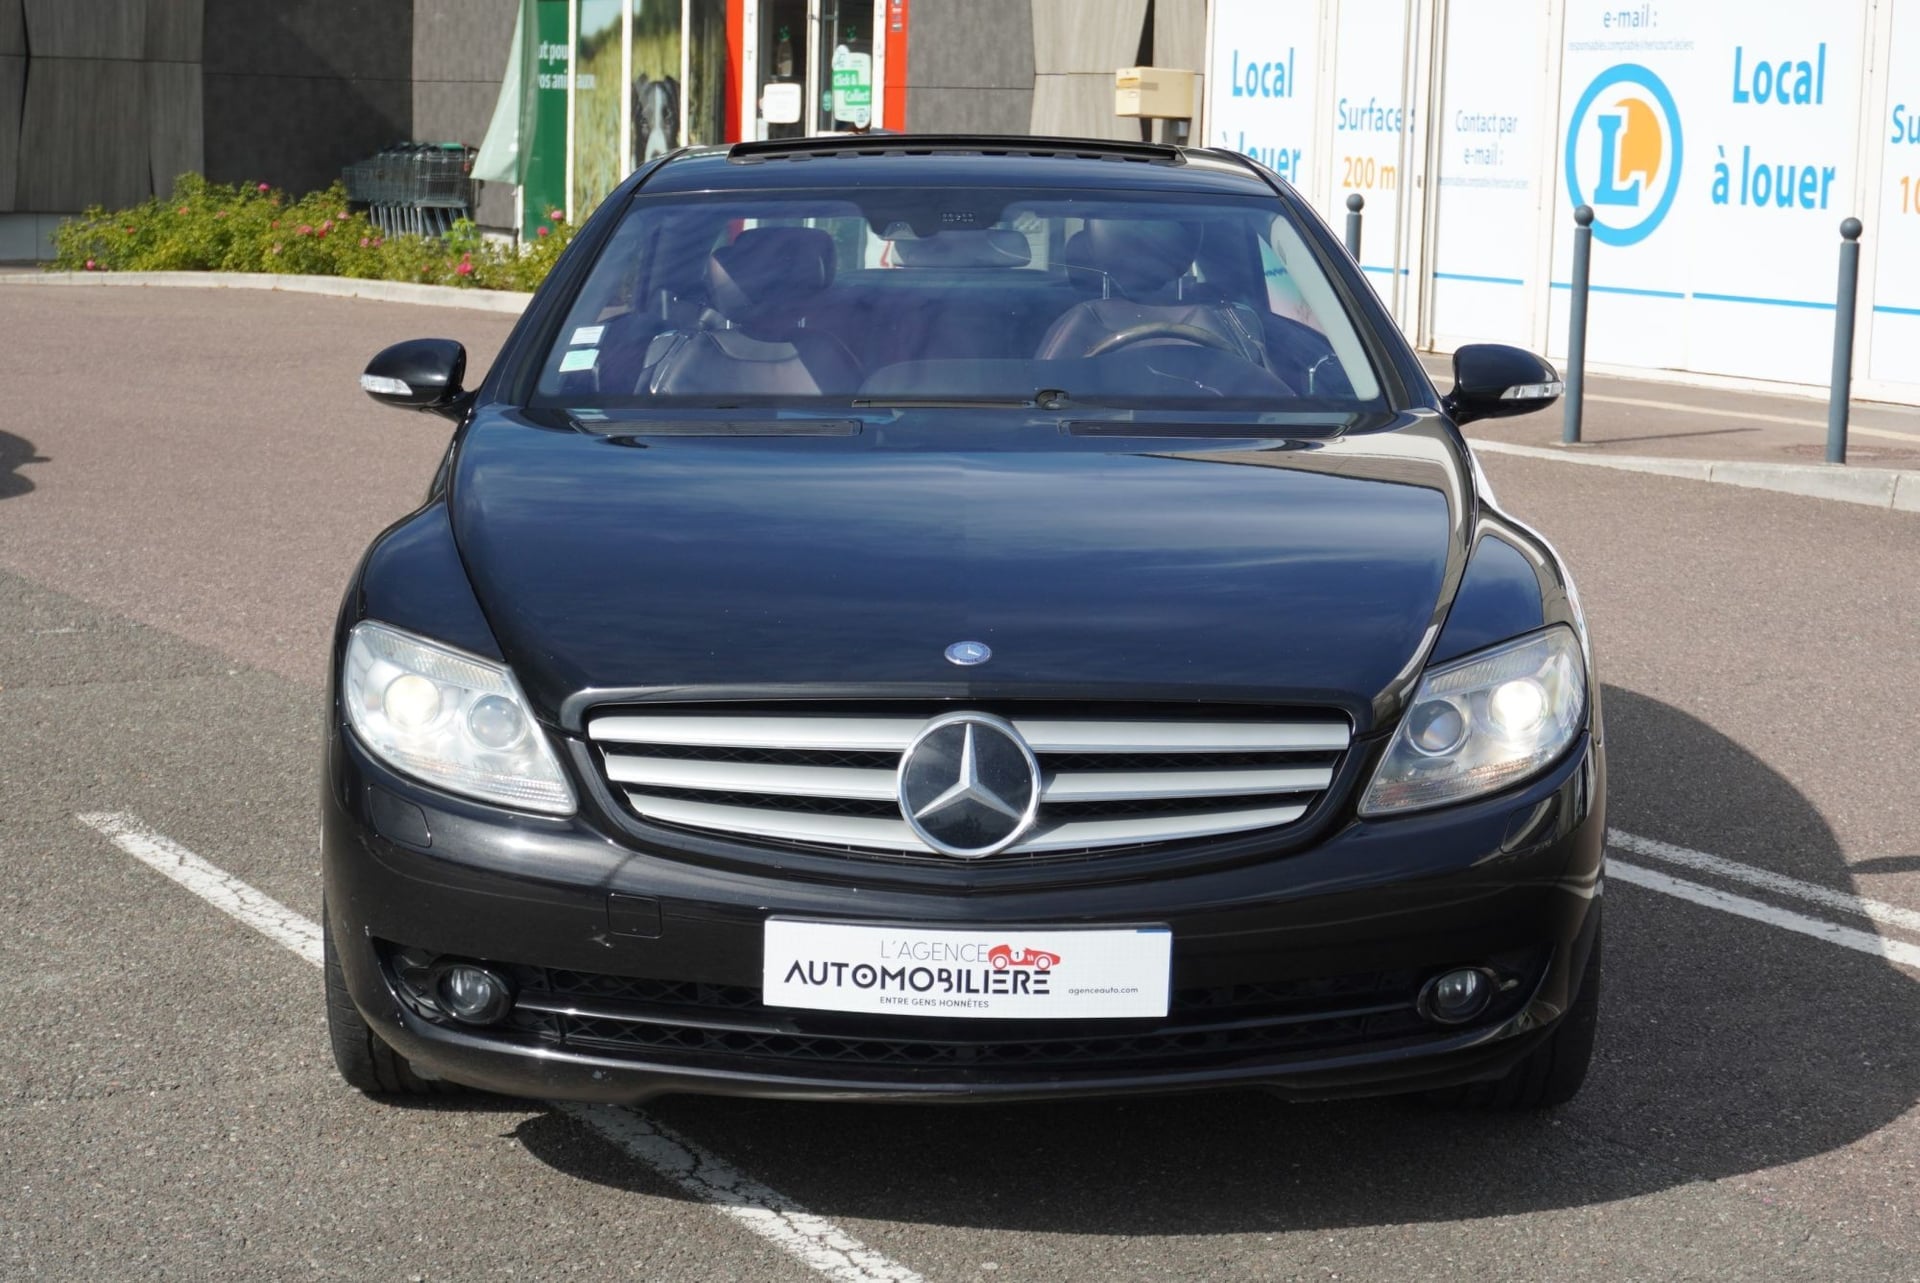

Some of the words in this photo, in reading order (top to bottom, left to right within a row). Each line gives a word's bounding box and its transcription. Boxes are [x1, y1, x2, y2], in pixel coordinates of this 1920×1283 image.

[1603, 3, 1650, 28] e-mail
[1232, 47, 1294, 98] Local
[1733, 42, 1827, 105] Local
[1338, 97, 1402, 132] Surface
[1456, 109, 1497, 133] Contact
[1499, 115, 1518, 139] par
[1464, 141, 1498, 166] e-mail
[1343, 156, 1375, 189] 200
[1711, 145, 1730, 205] à
[1740, 145, 1836, 210] louer
[880, 939, 989, 963] L'AGENCE
[880, 996, 909, 1006] ENTRE
[911, 998, 937, 1007] GENS
[939, 998, 990, 1009] HONNÊTES
[1068, 986, 1139, 996] agenceauto.com
